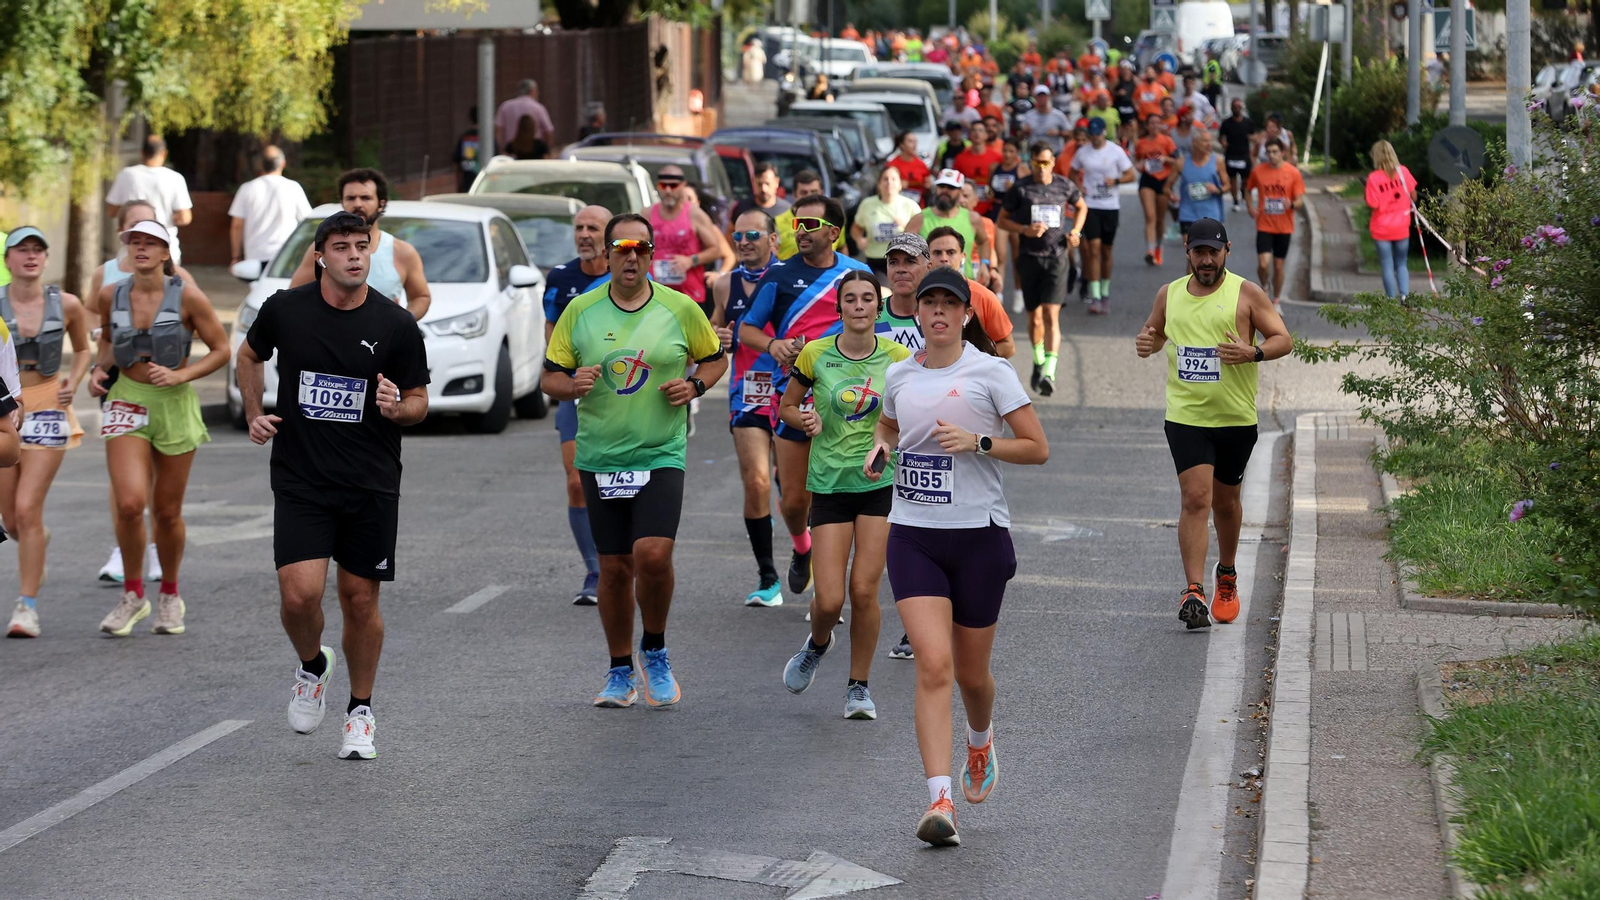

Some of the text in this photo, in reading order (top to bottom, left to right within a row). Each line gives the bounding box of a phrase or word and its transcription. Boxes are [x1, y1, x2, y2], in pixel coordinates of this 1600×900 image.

[1185, 358, 1209, 371] 994
[310, 388, 353, 408] 1096
[110, 411, 134, 424] 376
[34, 422, 60, 435] 678
[608, 470, 635, 485] 743
[901, 468, 943, 489] 1055
